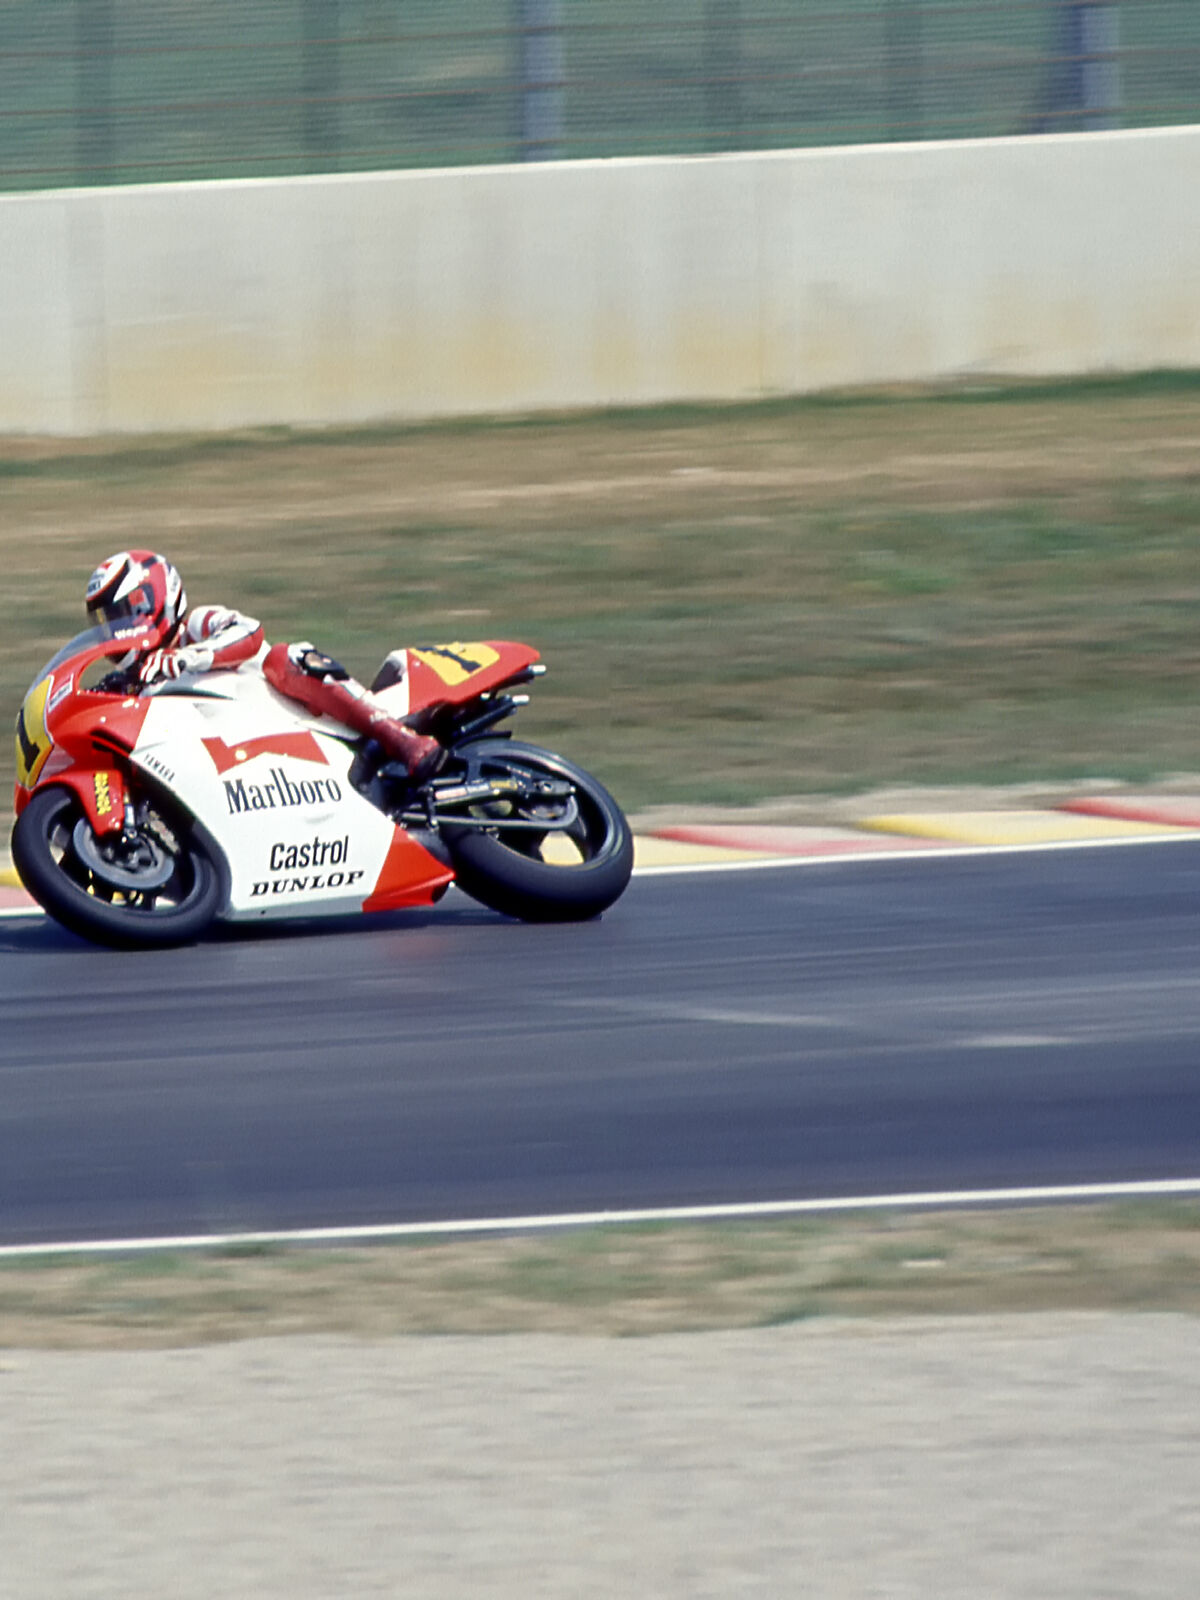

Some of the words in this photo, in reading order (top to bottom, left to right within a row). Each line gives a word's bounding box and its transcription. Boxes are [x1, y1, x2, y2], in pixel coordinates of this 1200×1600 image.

[223, 768, 342, 814] Marlboro
[269, 835, 349, 871] Castrol
[250, 870, 364, 896] DUNLOP
